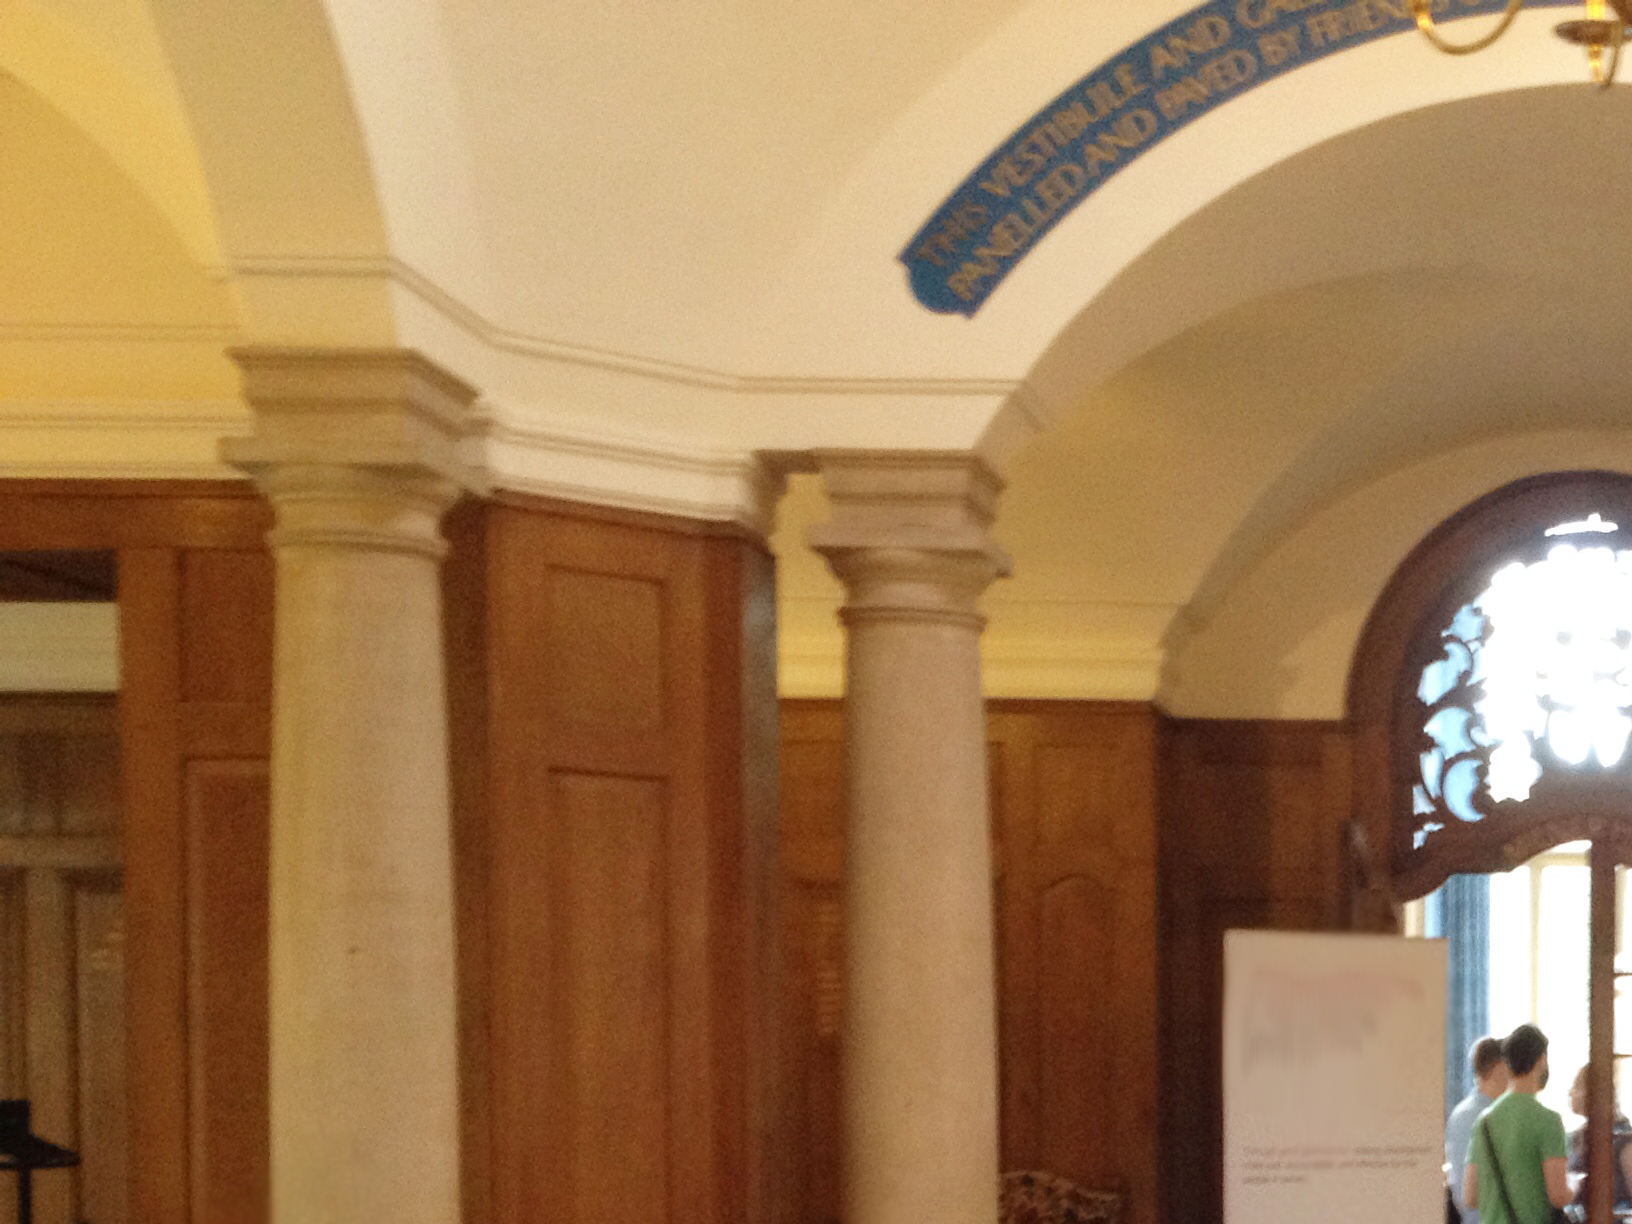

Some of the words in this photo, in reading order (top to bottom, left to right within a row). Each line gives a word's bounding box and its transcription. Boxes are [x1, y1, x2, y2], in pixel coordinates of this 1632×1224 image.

[946, 163, 1087, 301] PANELLED
[1083, 107, 1158, 178] AND
[1153, 49, 1257, 121] PAVED
[1257, 26, 1301, 67] BY
[977, 64, 1148, 198] VESTIBULE
[1150, 14, 1231, 79] AND
